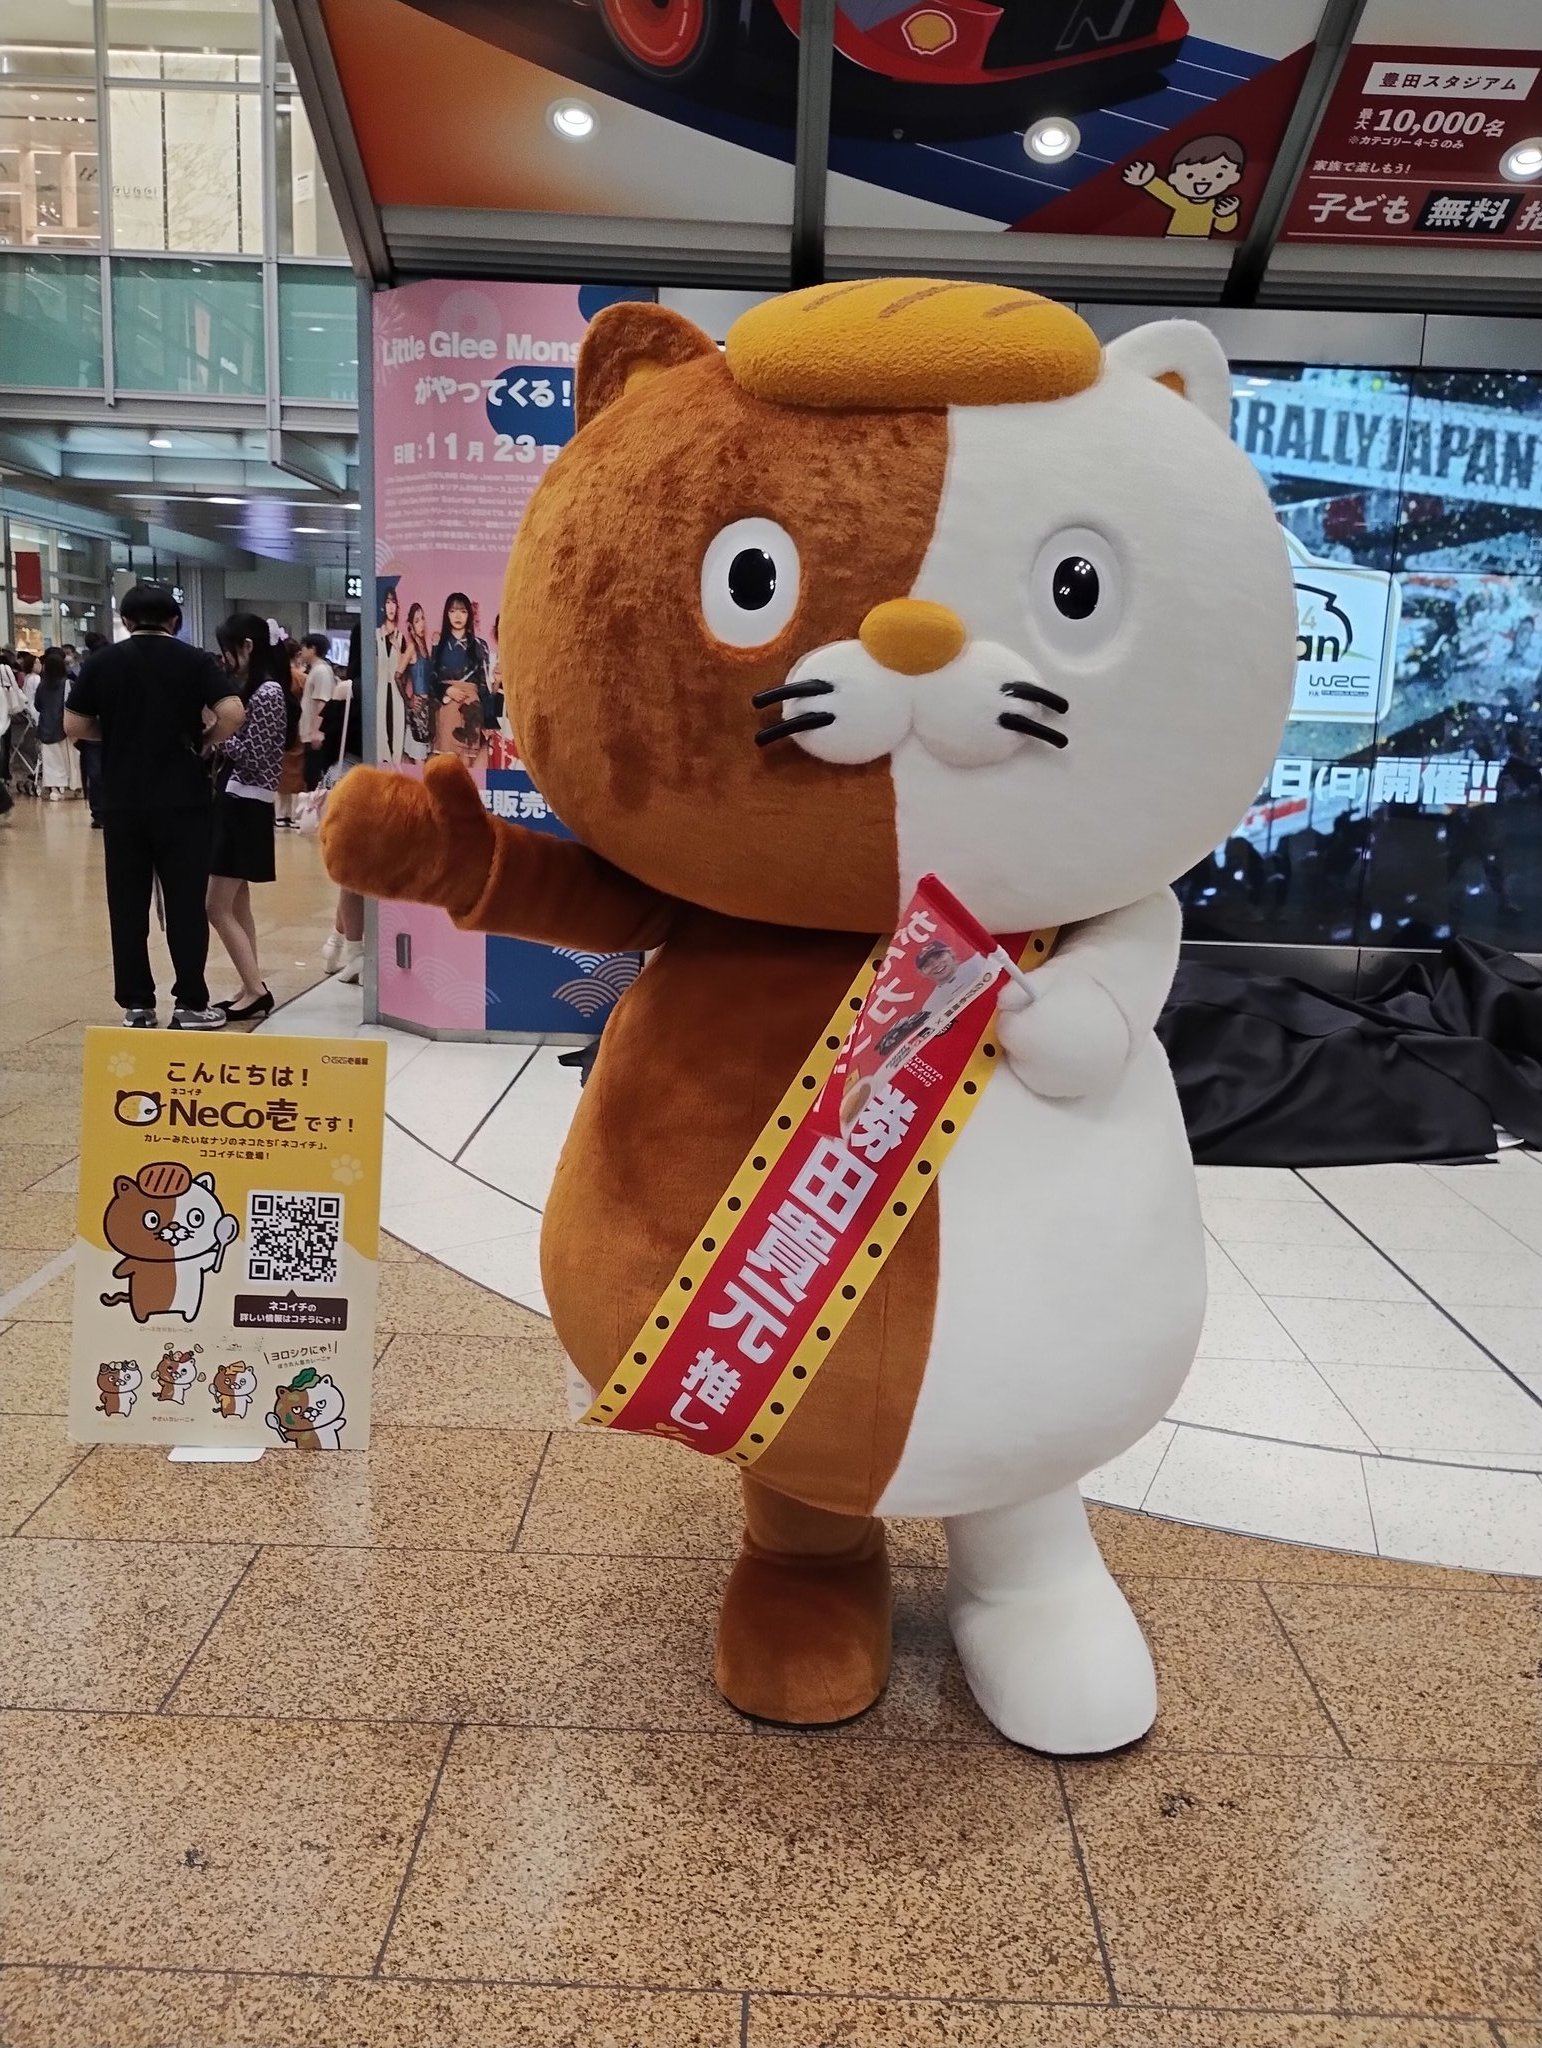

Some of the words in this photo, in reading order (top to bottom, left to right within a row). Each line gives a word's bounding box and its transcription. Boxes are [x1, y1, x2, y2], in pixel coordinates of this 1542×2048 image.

[1379, 72, 1517, 90] 豊田スタジアム
[1354, 107, 1374, 131] 最大
[1373, 108, 1506, 138] 10,000名
[1440, 140, 1464, 150] のみ
[1313, 160, 1411, 175] 家族で楽しもう!
[1308, 192, 1410, 225] 子ども
[1425, 196, 1511, 230] 無料
[383, 334, 425, 366] Little
[429, 330, 498, 360] Glee
[414, 376, 571, 408] がやってくる!
[1245, 399, 1383, 469] RALLY
[1381, 417, 1538, 491] JAPAN
[1309, 674, 1370, 689] WRC
[1270, 756, 1503, 805] 日(日)開催!!
[167, 1062, 309, 1087] こんにちは!
[170, 1088, 202, 1096] ネコイチ
[169, 1098, 299, 1132] NeCo壱
[304, 1116, 354, 1133] です!
[144, 1134, 328, 1150] カレーみたいなナゾのネコたち「ネコイチ」。
[200, 1149, 270, 1160] ココイチに登場!
[268, 1301, 317, 1312] ネコイチの
[239, 1312, 342, 1325] 詳しい情報はコチラにゃ!!
[271, 1343, 332, 1361] ヨロシクにゃ!
